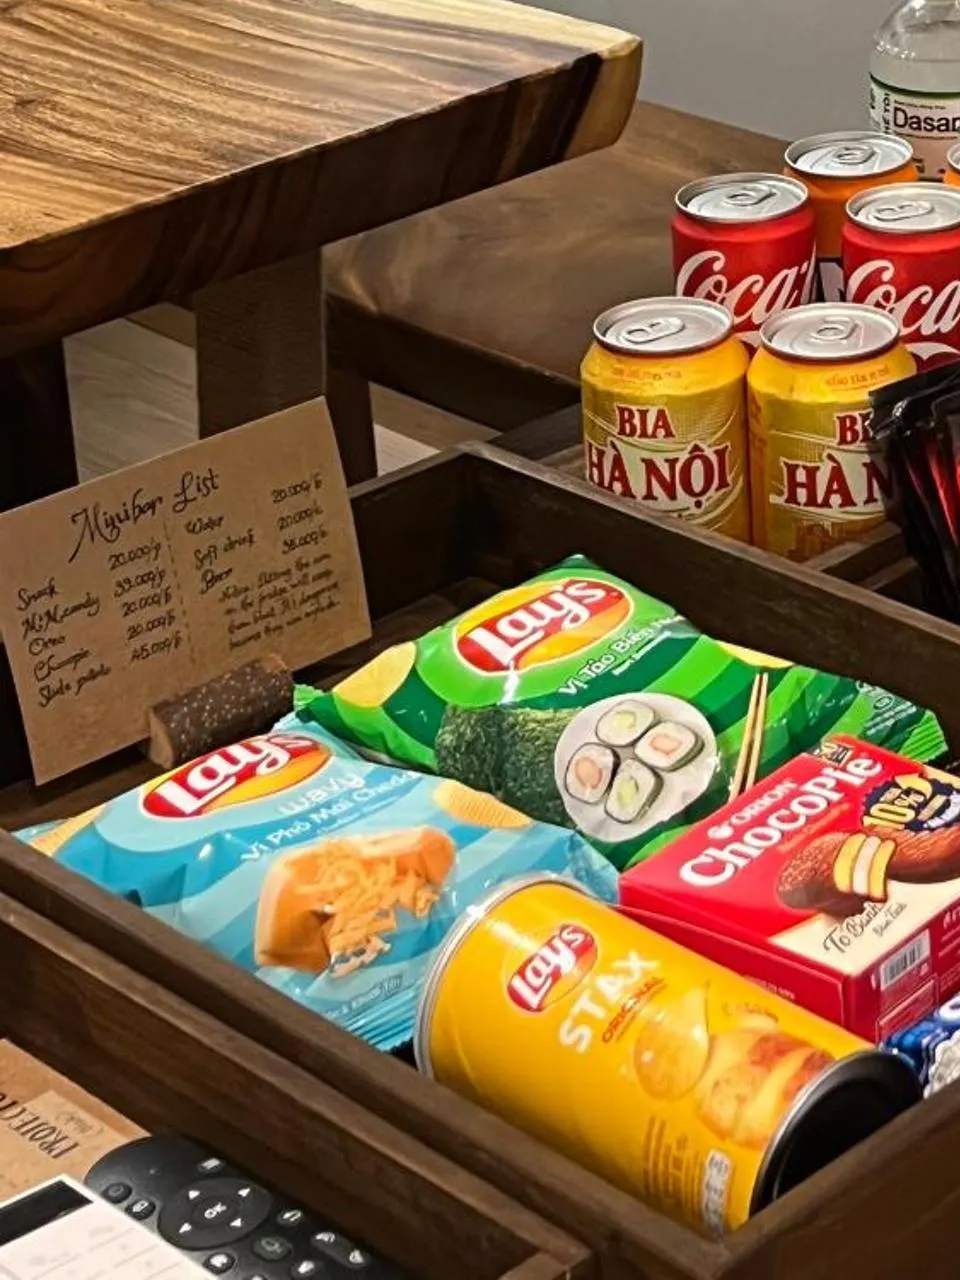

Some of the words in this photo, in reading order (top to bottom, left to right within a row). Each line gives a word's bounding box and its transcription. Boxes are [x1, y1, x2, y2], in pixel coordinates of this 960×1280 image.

[616, 405, 675, 438] BIA
[837, 413, 876, 446] BI
[172, 468, 219, 513] List
[588, 440, 636, 499] HÀ
[641, 443, 730, 509] NỘI
[784, 452, 857, 507] HÀ
[731, 778, 798, 825] ORION
[559, 950, 661, 1054] STAX
[204, 1201, 227, 1219] OK
